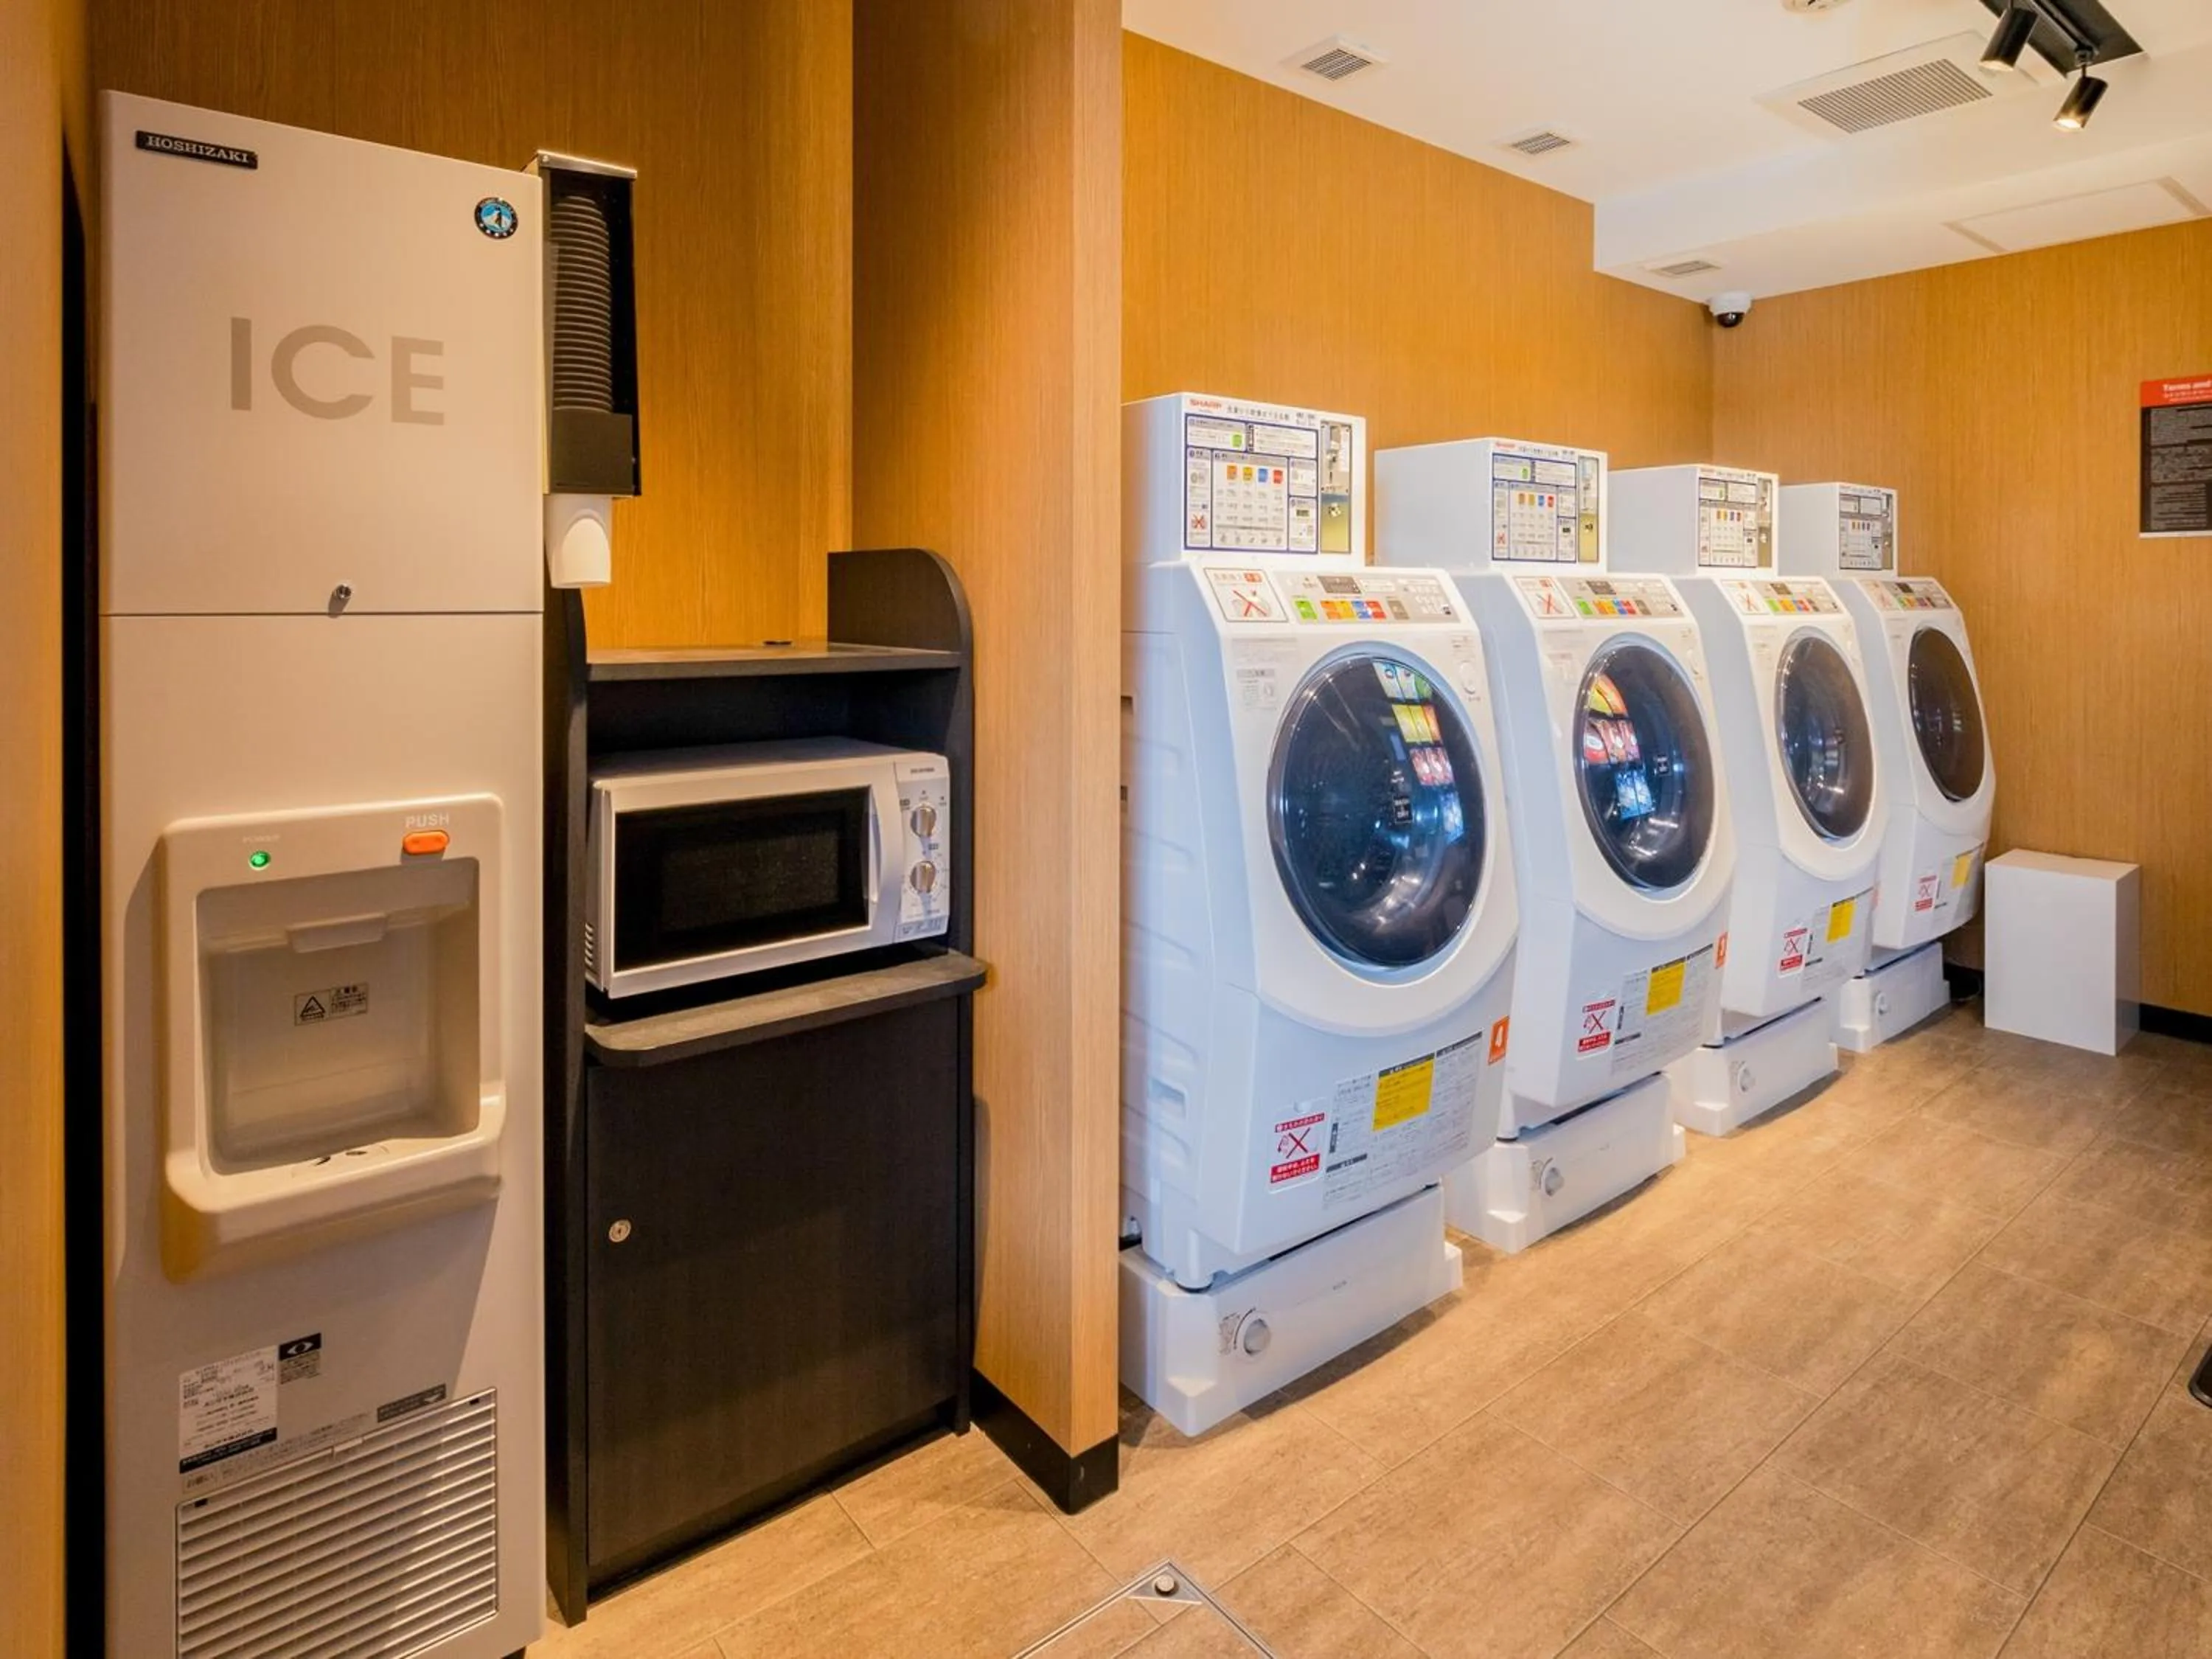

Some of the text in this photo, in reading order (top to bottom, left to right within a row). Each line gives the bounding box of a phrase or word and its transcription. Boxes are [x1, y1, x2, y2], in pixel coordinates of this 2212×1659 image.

[147, 136, 249, 163] HOSHIZAKI
[230, 317, 445, 425] ICE
[406, 813, 450, 828] PUSH
